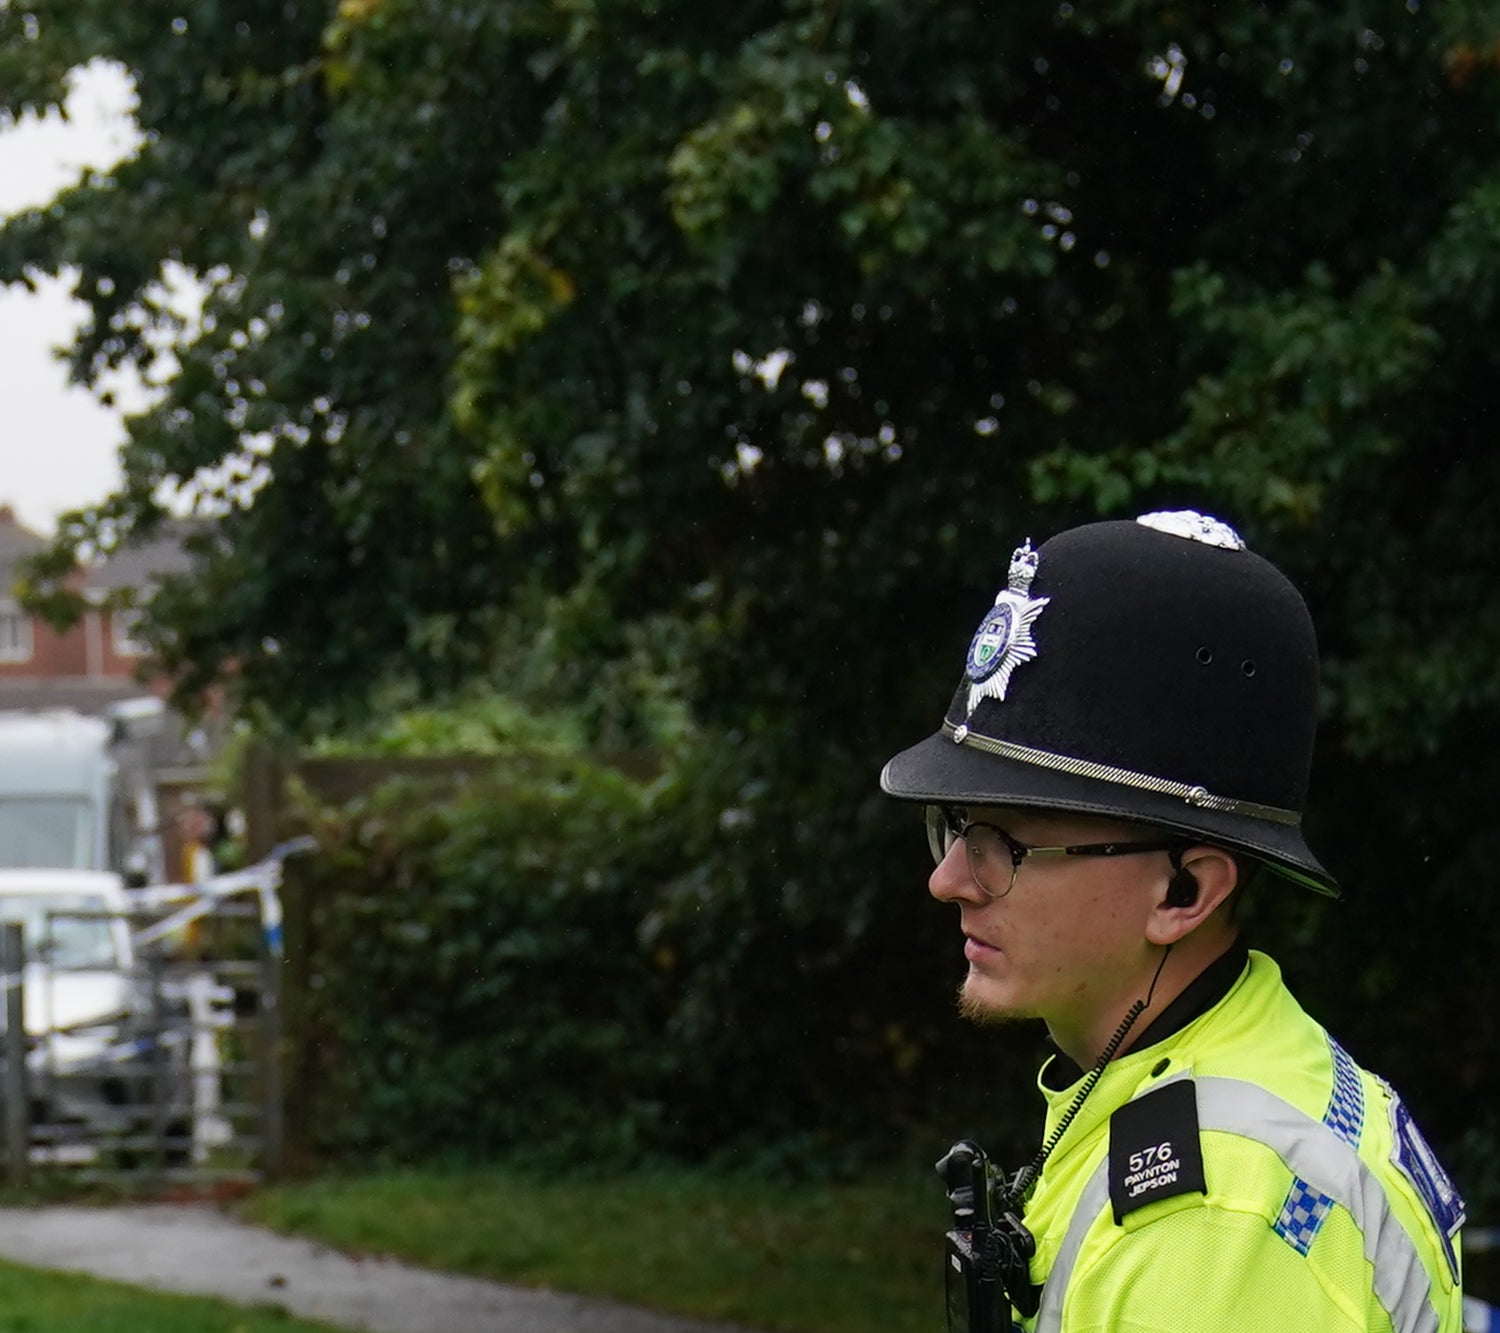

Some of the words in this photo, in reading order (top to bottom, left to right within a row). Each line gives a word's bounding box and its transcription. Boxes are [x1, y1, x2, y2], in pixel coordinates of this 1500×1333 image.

[1129, 1142, 1172, 1172] 576
[1124, 1159, 1180, 1187] PAYNTON
[1128, 1172, 1177, 1197] JEPSON
